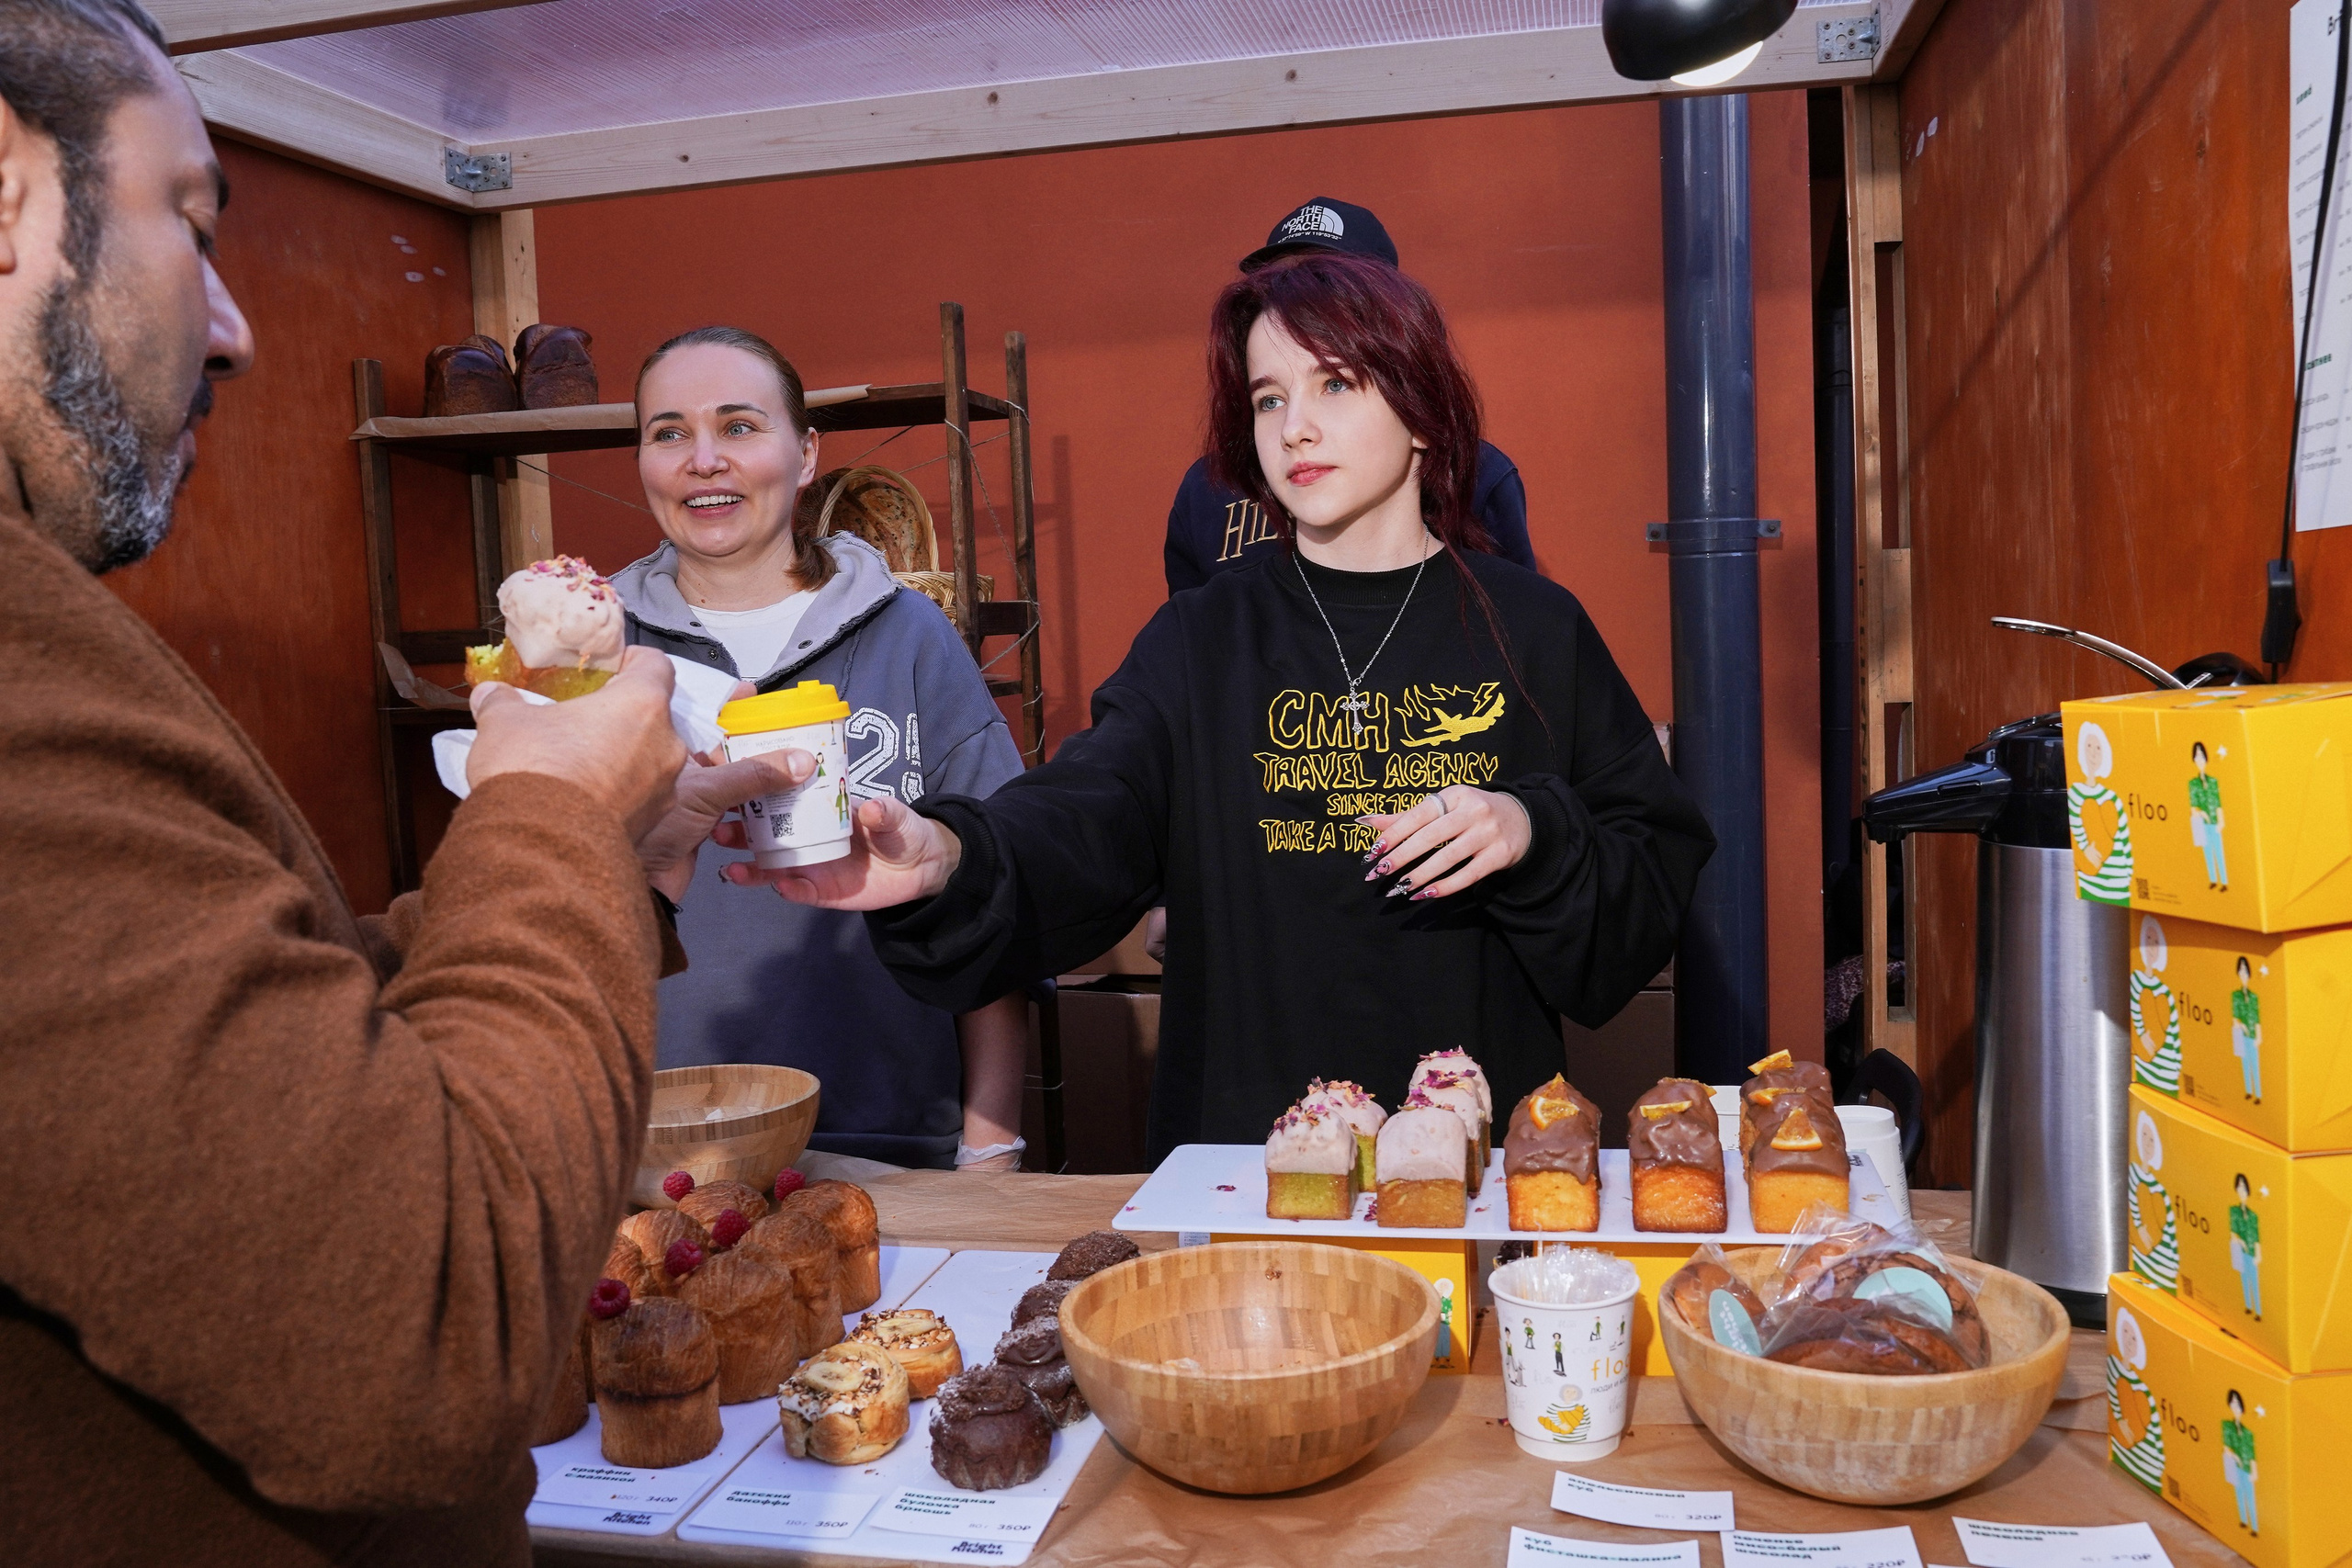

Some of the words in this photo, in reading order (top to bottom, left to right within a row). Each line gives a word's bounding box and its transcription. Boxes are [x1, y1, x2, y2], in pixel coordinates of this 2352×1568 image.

[1300, 205, 1324, 216] THE
[1281, 213, 1321, 232] NORTH
[1288, 221, 1320, 234] FACE
[1216, 499, 1279, 562] HIL
[1269, 689, 1389, 752] CMH
[1253, 751, 1377, 793] TRAVEL
[1383, 751, 1499, 788] AGENCY
[1327, 792, 1386, 816] SINCE
[2128, 793, 2168, 821] floo
[1259, 819, 1315, 852] TAKE
[1317, 823, 1336, 852] A
[2178, 991, 2213, 1025] floo
[2174, 1195, 2210, 1235] floo
[2161, 1398, 2200, 1443] floo
[571, 1467, 631, 1476] краффин
[576, 1474, 636, 1483] малиной
[1567, 1483, 1594, 1493] куб
[726, 1496, 790, 1506] баноффи
[899, 1498, 960, 1509] булочка
[904, 1492, 996, 1505] шоколадная
[613, 1512, 652, 1520] Bright
[894, 1505, 952, 1516] бриошь
[603, 1517, 651, 1526] Kitchen
[1524, 1536, 1552, 1545] куб
[1733, 1535, 1804, 1544] печенье
[951, 1546, 1003, 1555] Kitchen
[960, 1541, 1003, 1550] Bright
[1734, 1541, 1841, 1551] мисо-белый
[1523, 1544, 1681, 1562] фисташка-малина
[1735, 1548, 1812, 1560] шоколад
